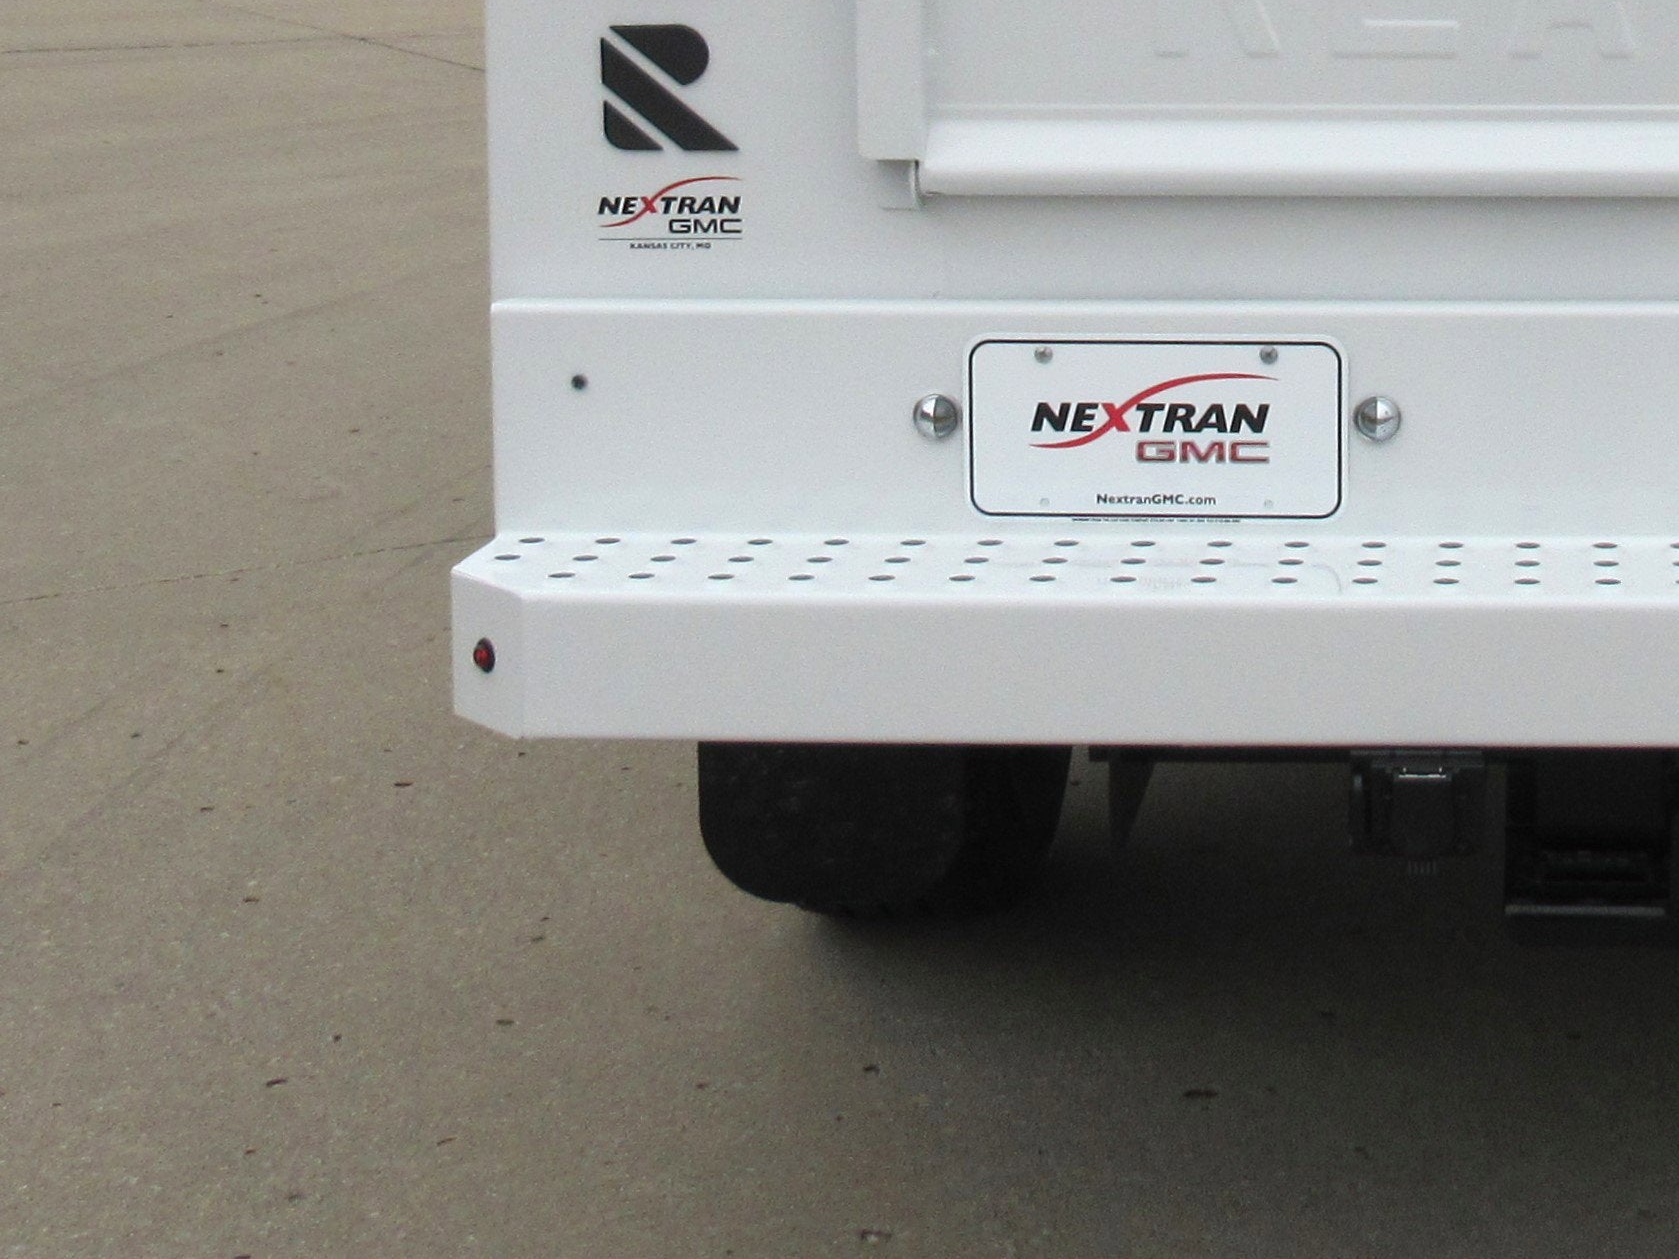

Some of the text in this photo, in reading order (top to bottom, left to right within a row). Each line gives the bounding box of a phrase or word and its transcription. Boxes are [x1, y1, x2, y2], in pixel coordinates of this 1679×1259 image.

[598, 196, 742, 216] NEXTRAN
[669, 218, 743, 234] GMC
[1030, 402, 1270, 433] NEXTRAN
[1136, 440, 1271, 464] GMC
[1096, 493, 1217, 506] NextranGMC.com
